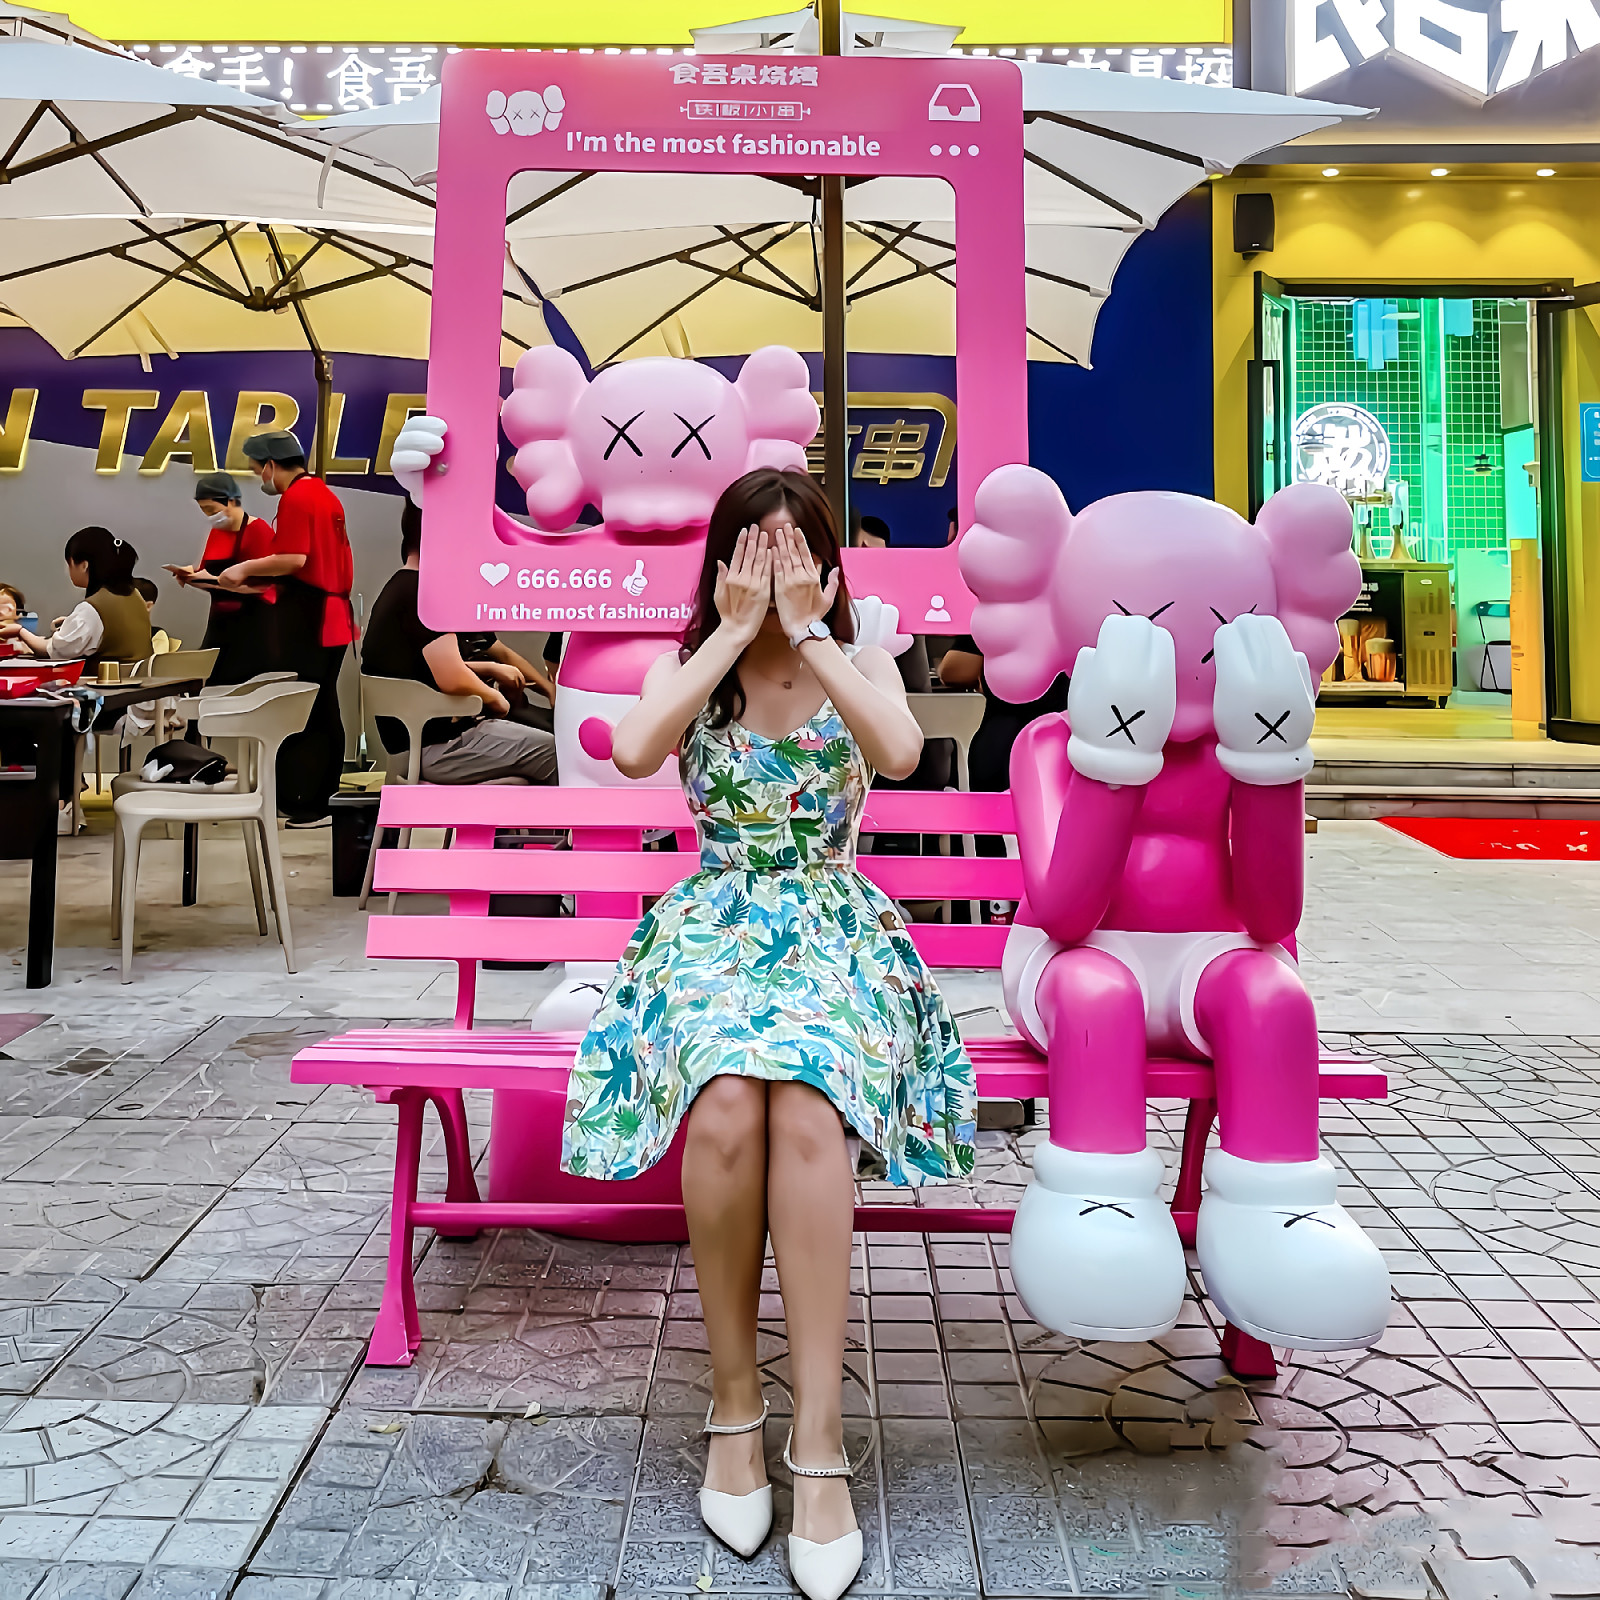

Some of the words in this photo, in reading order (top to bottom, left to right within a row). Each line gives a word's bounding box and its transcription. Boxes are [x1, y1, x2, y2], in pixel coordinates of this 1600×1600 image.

[566, 131, 607, 152] I'm
[614, 132, 656, 153] the
[662, 135, 726, 154] most
[732, 133, 881, 157] fashionable
[516, 568, 613, 589] 666.666
[476, 603, 507, 620] I'm
[511, 603, 542, 620] the
[546, 604, 595, 620] most
[599, 602, 693, 620] fashionab
